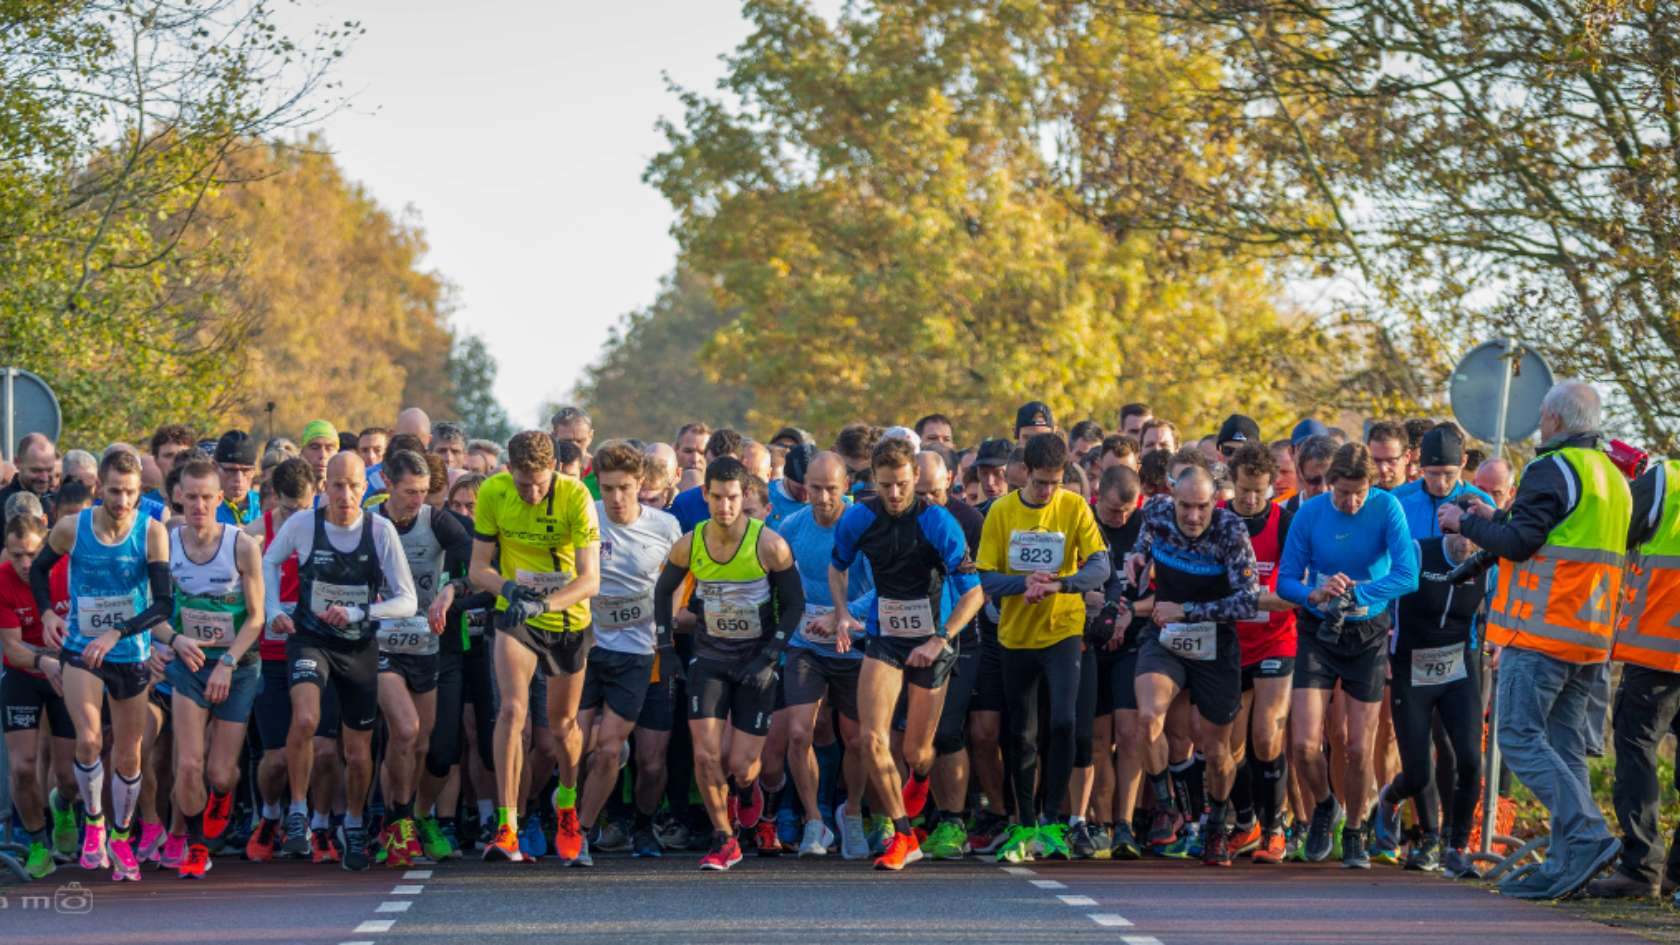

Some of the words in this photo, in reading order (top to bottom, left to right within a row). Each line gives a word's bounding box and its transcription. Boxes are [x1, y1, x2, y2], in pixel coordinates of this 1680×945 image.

[1020, 547, 1052, 564] 823
[90, 611, 126, 629] 645
[610, 606, 642, 623] 169
[889, 615, 922, 630] 615
[193, 624, 225, 640] 159
[717, 618, 749, 632] 650
[388, 632, 419, 646] 678
[1171, 637, 1202, 652] 561
[1424, 659, 1454, 677] 797
